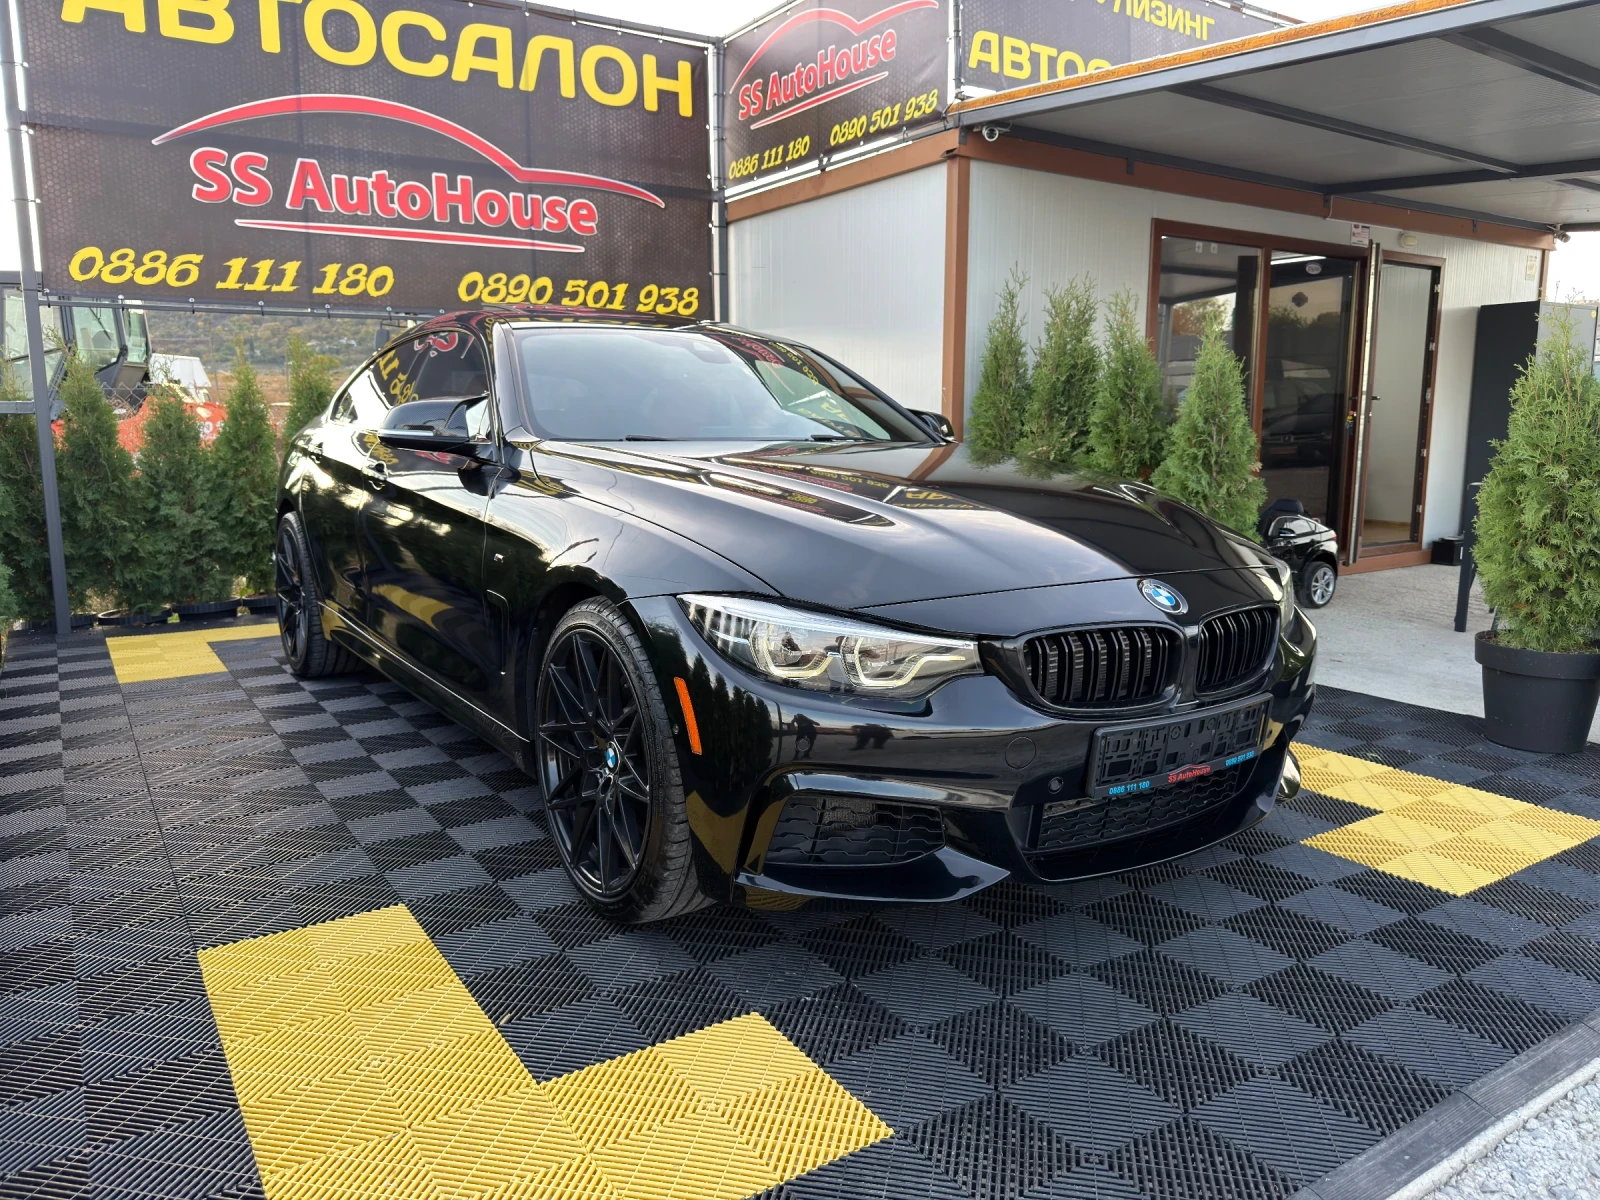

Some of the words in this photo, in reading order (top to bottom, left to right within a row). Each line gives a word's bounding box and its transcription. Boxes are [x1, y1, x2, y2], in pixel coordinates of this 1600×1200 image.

[738, 78, 764, 121] SS
[766, 29, 897, 111] AutoHouse
[968, 31, 1113, 83] АВТО
[829, 114, 868, 147] 0890
[868, 103, 902, 133] 501
[903, 89, 939, 122] 938
[728, 152, 760, 181] 0886
[760, 144, 785, 171] 111
[785, 134, 811, 162] 180
[189, 147, 274, 207] SS
[287, 157, 599, 236] AutoHouse
[67, 245, 205, 288] 0886
[215, 256, 303, 293] 111
[311, 262, 396, 298] 180
[456, 270, 554, 306] 0890
[560, 279, 629, 311] 501
[635, 283, 700, 316] 938
